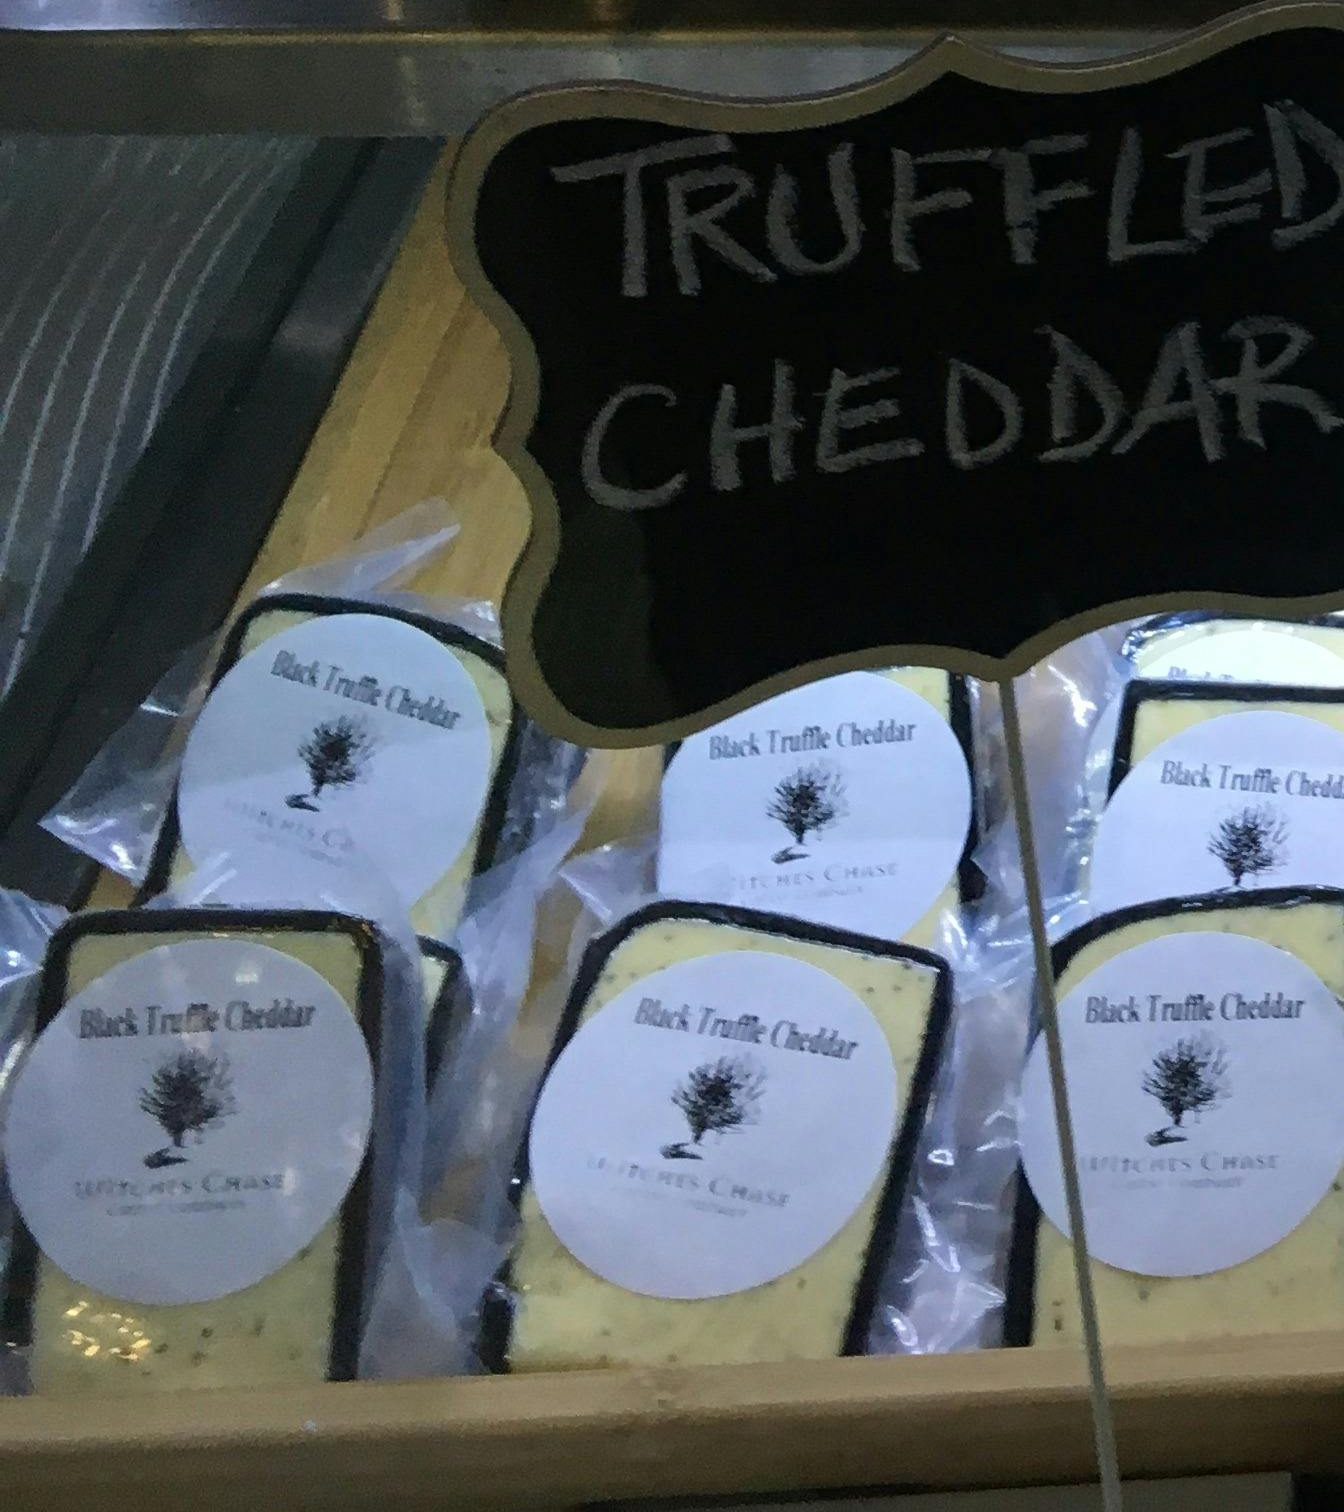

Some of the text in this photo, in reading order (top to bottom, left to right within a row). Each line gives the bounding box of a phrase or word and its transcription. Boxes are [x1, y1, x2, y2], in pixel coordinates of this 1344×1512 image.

[709, 719, 916, 760] Black Truffle Cheddar
[1161, 760, 1211, 789] Black
[1219, 765, 1281, 794] Truffle
[80, 1007, 138, 1039] Black
[225, 998, 316, 1031] Cheddar
[634, 997, 859, 1060] Black Truffle Cheddar
[1085, 992, 1305, 1024] Black Truffle Cheddar
